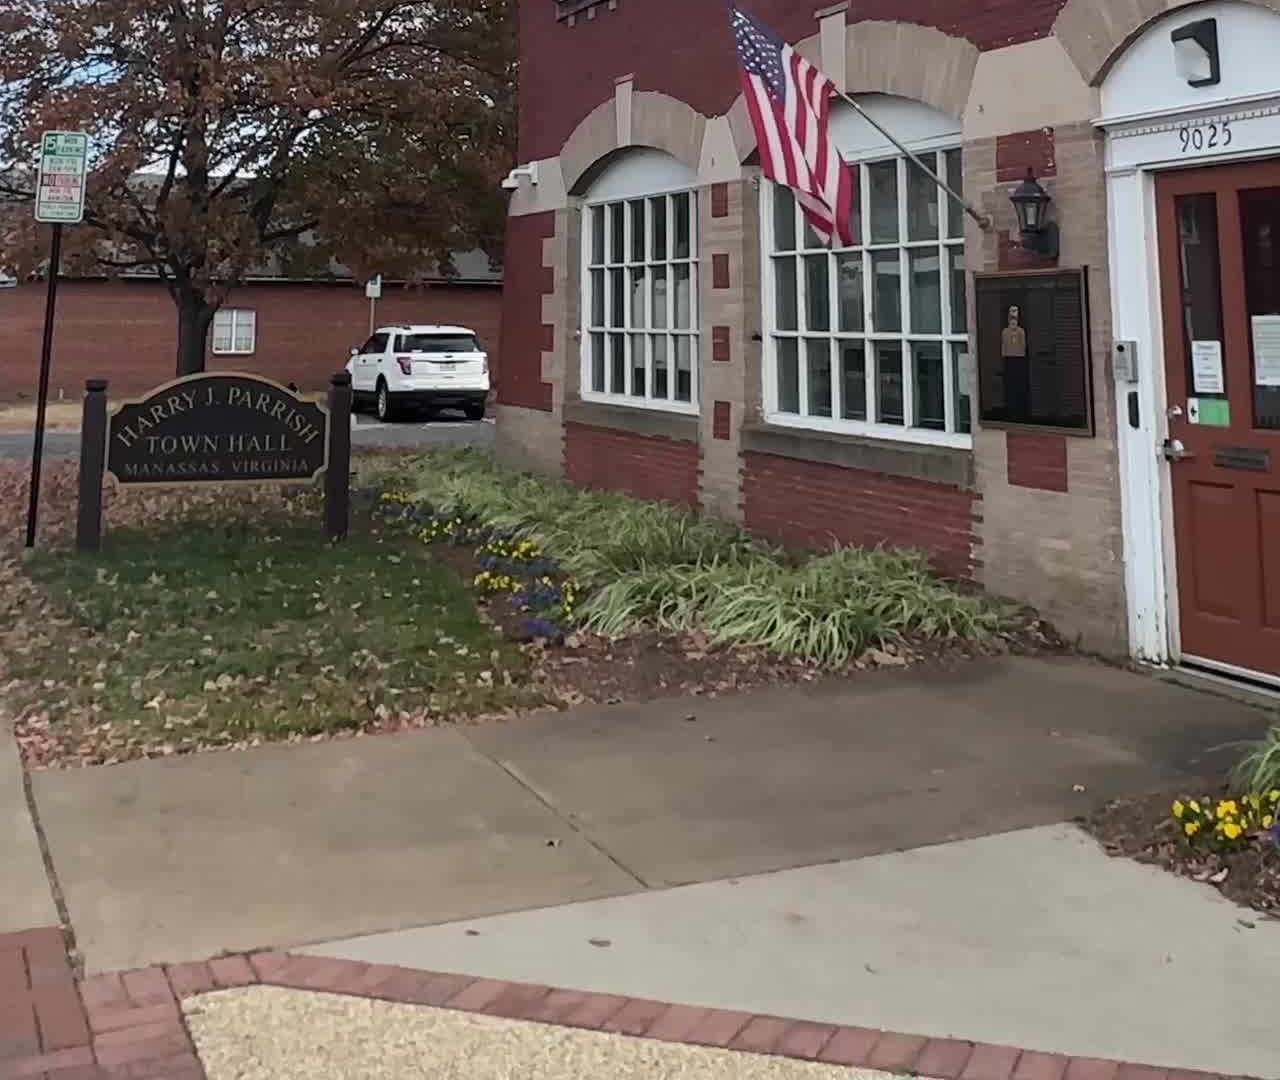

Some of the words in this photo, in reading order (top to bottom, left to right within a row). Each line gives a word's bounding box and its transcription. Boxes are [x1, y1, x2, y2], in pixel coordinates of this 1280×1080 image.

[1179, 121, 1232, 153] 9025
[116, 387, 199, 448] HARRY
[204, 386, 220, 407] J.
[227, 386, 320, 445] PARRISH
[145, 434, 219, 455] TOWN
[228, 432, 294, 453] HALL
[231, 458, 310, 472] VIRGINIA
